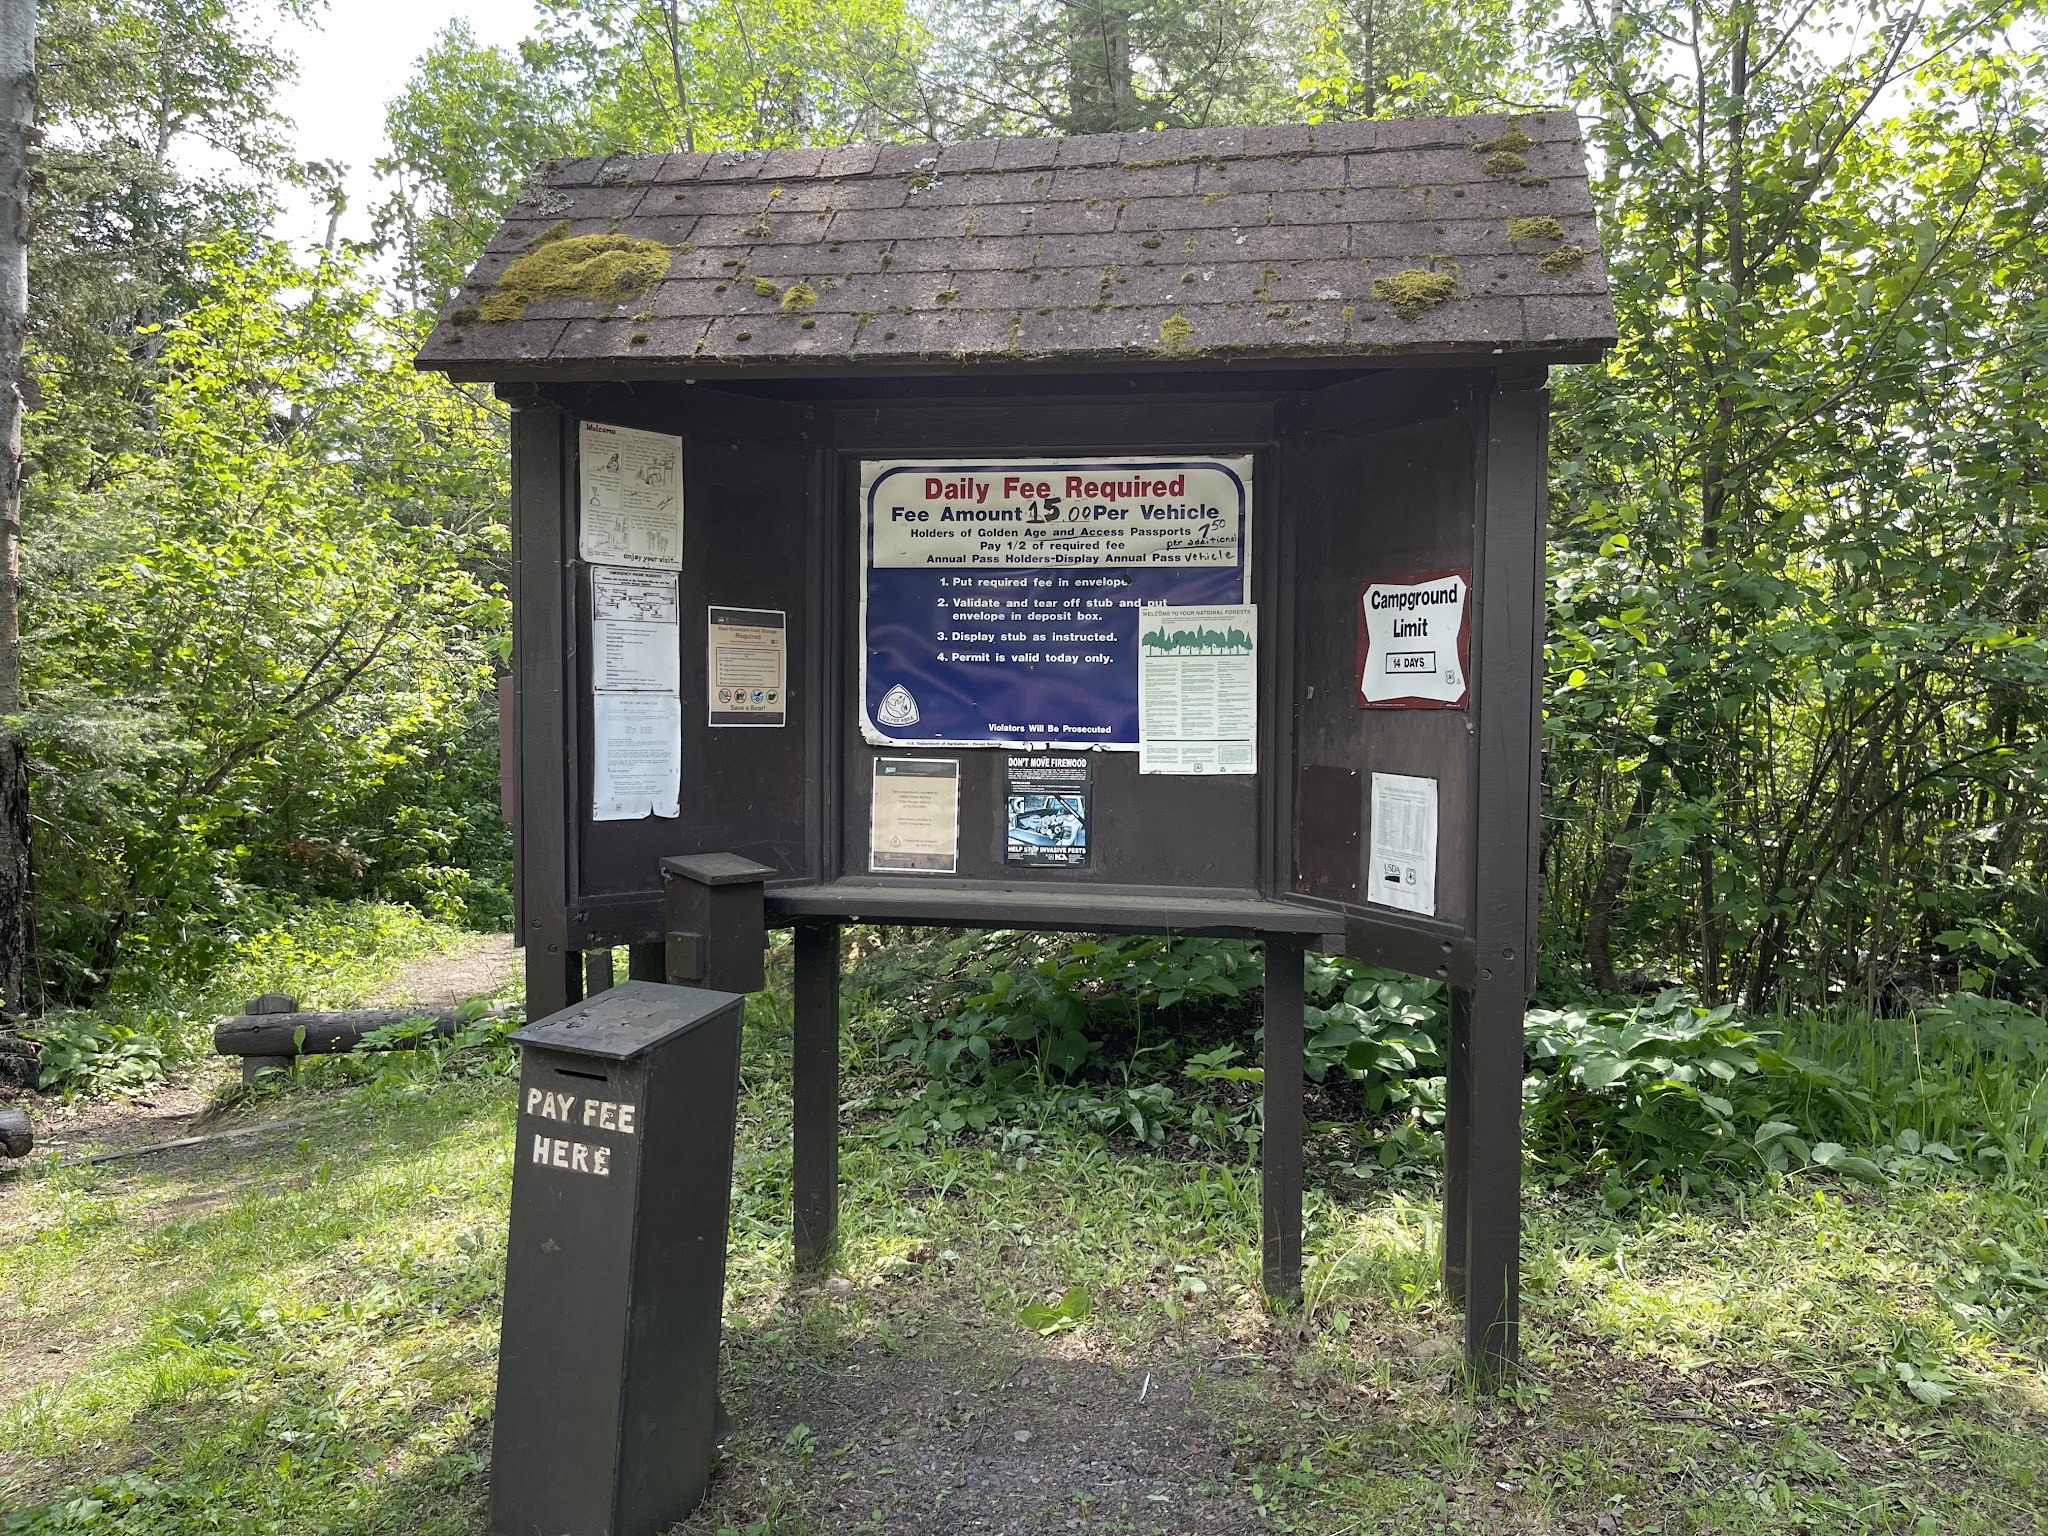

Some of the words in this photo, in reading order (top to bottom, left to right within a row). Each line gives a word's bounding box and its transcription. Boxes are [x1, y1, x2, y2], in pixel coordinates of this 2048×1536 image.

[925, 477, 990, 504] Daily
[1004, 477, 1051, 499] Fee
[1065, 474, 1185, 502] Required
[891, 506, 930, 522] Fee
[940, 506, 1022, 522] Amount
[1093, 505, 1129, 521] Per
[1140, 503, 1220, 520] Vehicle
[910, 529, 955, 538] Holders
[960, 528, 972, 537] of
[977, 528, 1018, 537] Golden
[1024, 528, 1047, 539] Age
[1052, 528, 1075, 536] and
[1080, 527, 1124, 536] Access
[1130, 527, 1191, 538] Passports
[980, 541, 1001, 552] Pay
[1007, 541, 1026, 550] 1/2
[1032, 541, 1044, 550] of
[1050, 540, 1100, 552] required
[1106, 541, 1125, 550] fee
[1166, 540, 1183, 551] per
[1187, 533, 1237, 547] additional
[623, 553, 642, 563] enjoy
[643, 555, 658, 563] your
[926, 554, 966, 563] Annual
[972, 554, 1000, 563] Pass
[1005, 553, 1099, 564] Holders-Display
[1105, 553, 1146, 562] Annual
[1152, 553, 1181, 562] Pass
[939, 578, 949, 587] 1.
[952, 577, 973, 587] Put
[977, 577, 1028, 590] required
[1033, 577, 1053, 587] fee
[1058, 577, 1069, 587] in
[937, 598, 949, 607] 2.
[952, 598, 1000, 608] Validate
[1005, 598, 1028, 608] and
[1034, 598, 1058, 608] tear
[1063, 598, 1081, 608] off
[1086, 598, 1113, 608] stub
[1118, 597, 1141, 608] and
[1147, 599, 1168, 607] put
[1371, 583, 1458, 611] Campground
[952, 612, 1006, 622] envelope
[1011, 612, 1022, 621] in
[1027, 611, 1072, 622] deposit
[1077, 611, 1103, 621] box.
[1393, 617, 1428, 637] Limit
[735, 632, 762, 640] Required
[936, 631, 949, 641] 3.
[951, 631, 995, 643] Display
[1000, 631, 1027, 641] stub
[1032, 633, 1047, 641] as
[1052, 631, 1118, 642] instructed.
[936, 653, 949, 662] 4.
[951, 652, 990, 662] Permit
[995, 652, 1006, 662] is
[1011, 652, 1040, 663] valid
[1045, 653, 1079, 664] today
[1084, 653, 1114, 665] only.
[1404, 657, 1425, 668] DAYS
[988, 723, 1025, 733] Violators
[1029, 724, 1044, 733] Will
[1047, 724, 1060, 733] Be
[1063, 725, 1112, 734] Prosecuted
[1008, 757, 1030, 767] DON'T
[1030, 757, 1051, 768] MOVE
[1050, 758, 1087, 768] FIREWOOD
[1039, 846, 1067, 854] INVASIVE
[1384, 863, 1401, 874] USDA
[526, 1087, 576, 1122] PAY
[583, 1098, 636, 1134] FEE
[532, 1133, 611, 1176] HERE
